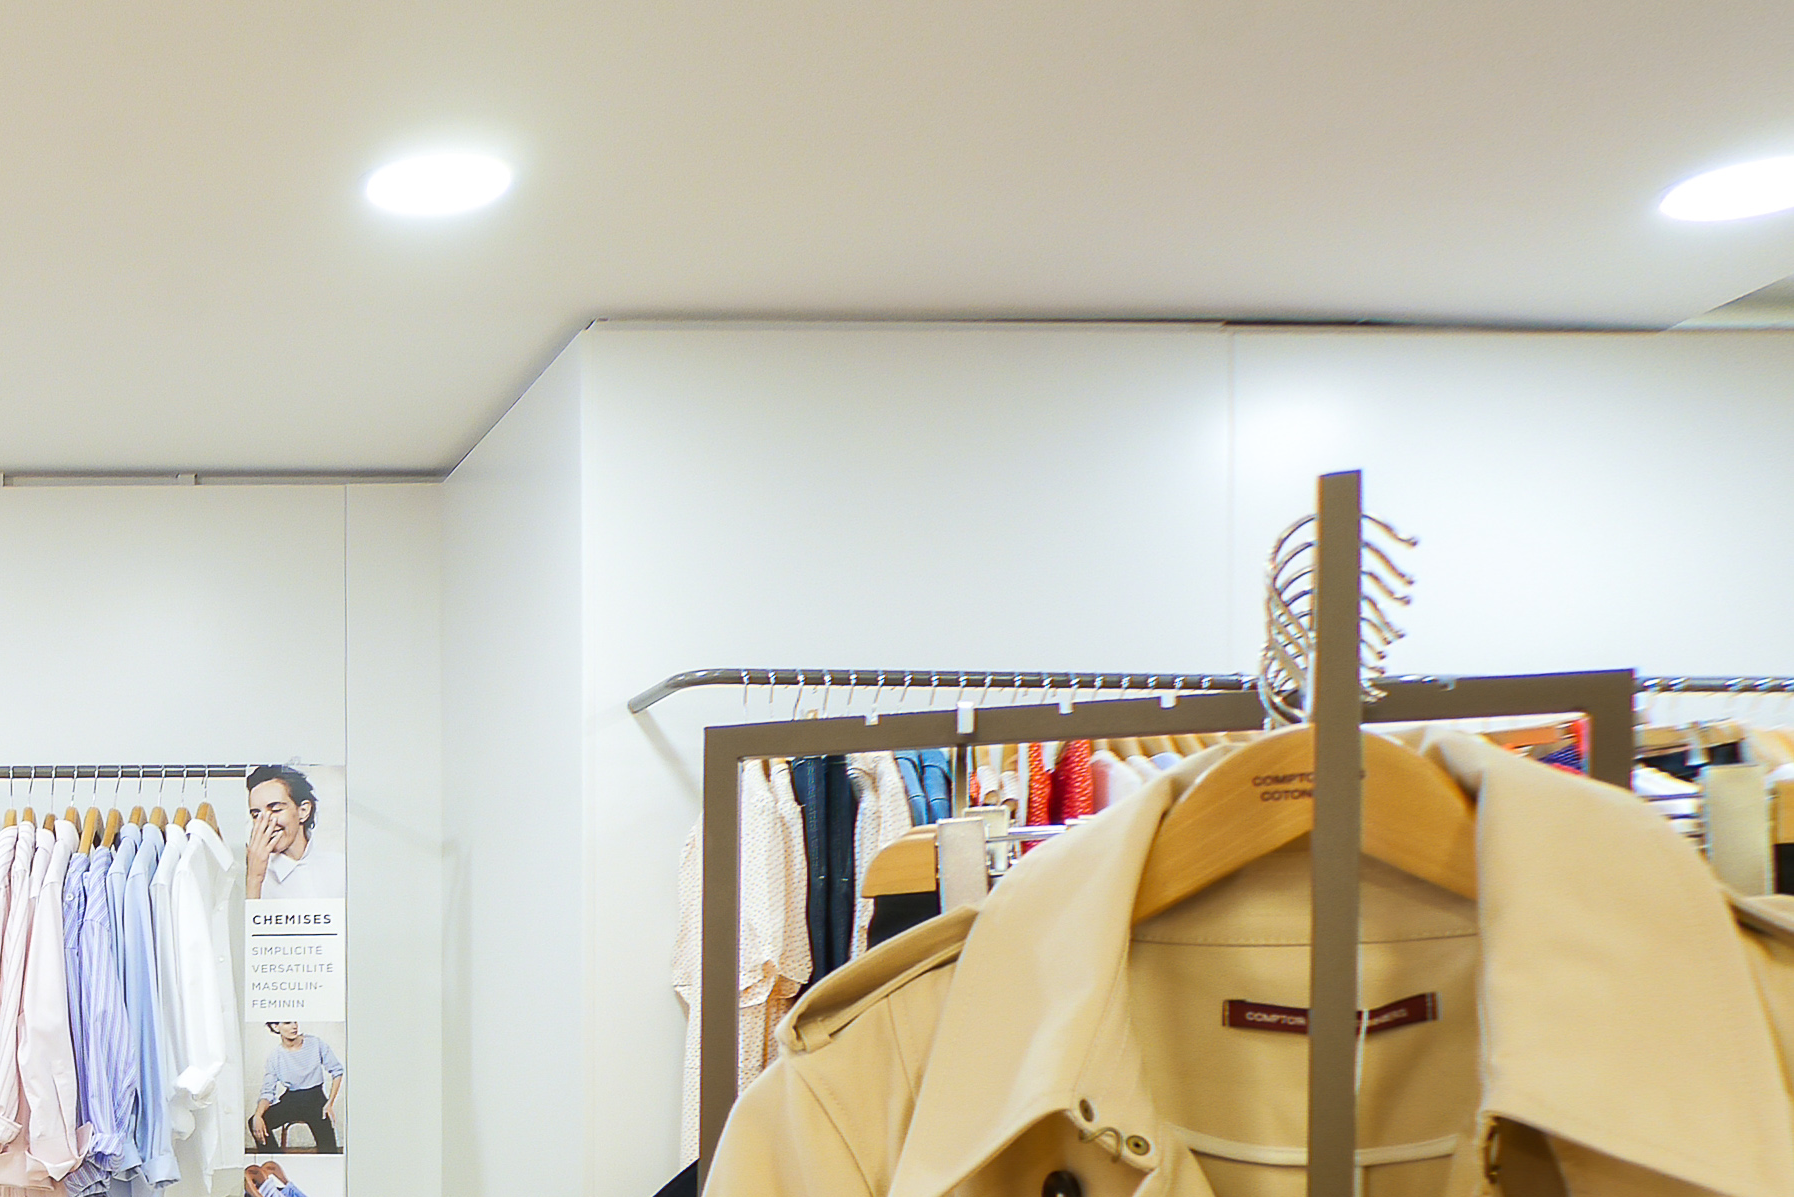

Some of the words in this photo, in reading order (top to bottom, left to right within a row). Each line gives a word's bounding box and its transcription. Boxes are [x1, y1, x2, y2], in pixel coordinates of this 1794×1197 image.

[252, 914, 332, 925] CHEMISES
[252, 962, 334, 973] VERSATILITÉ
[252, 981, 324, 991] MASCULIN-
